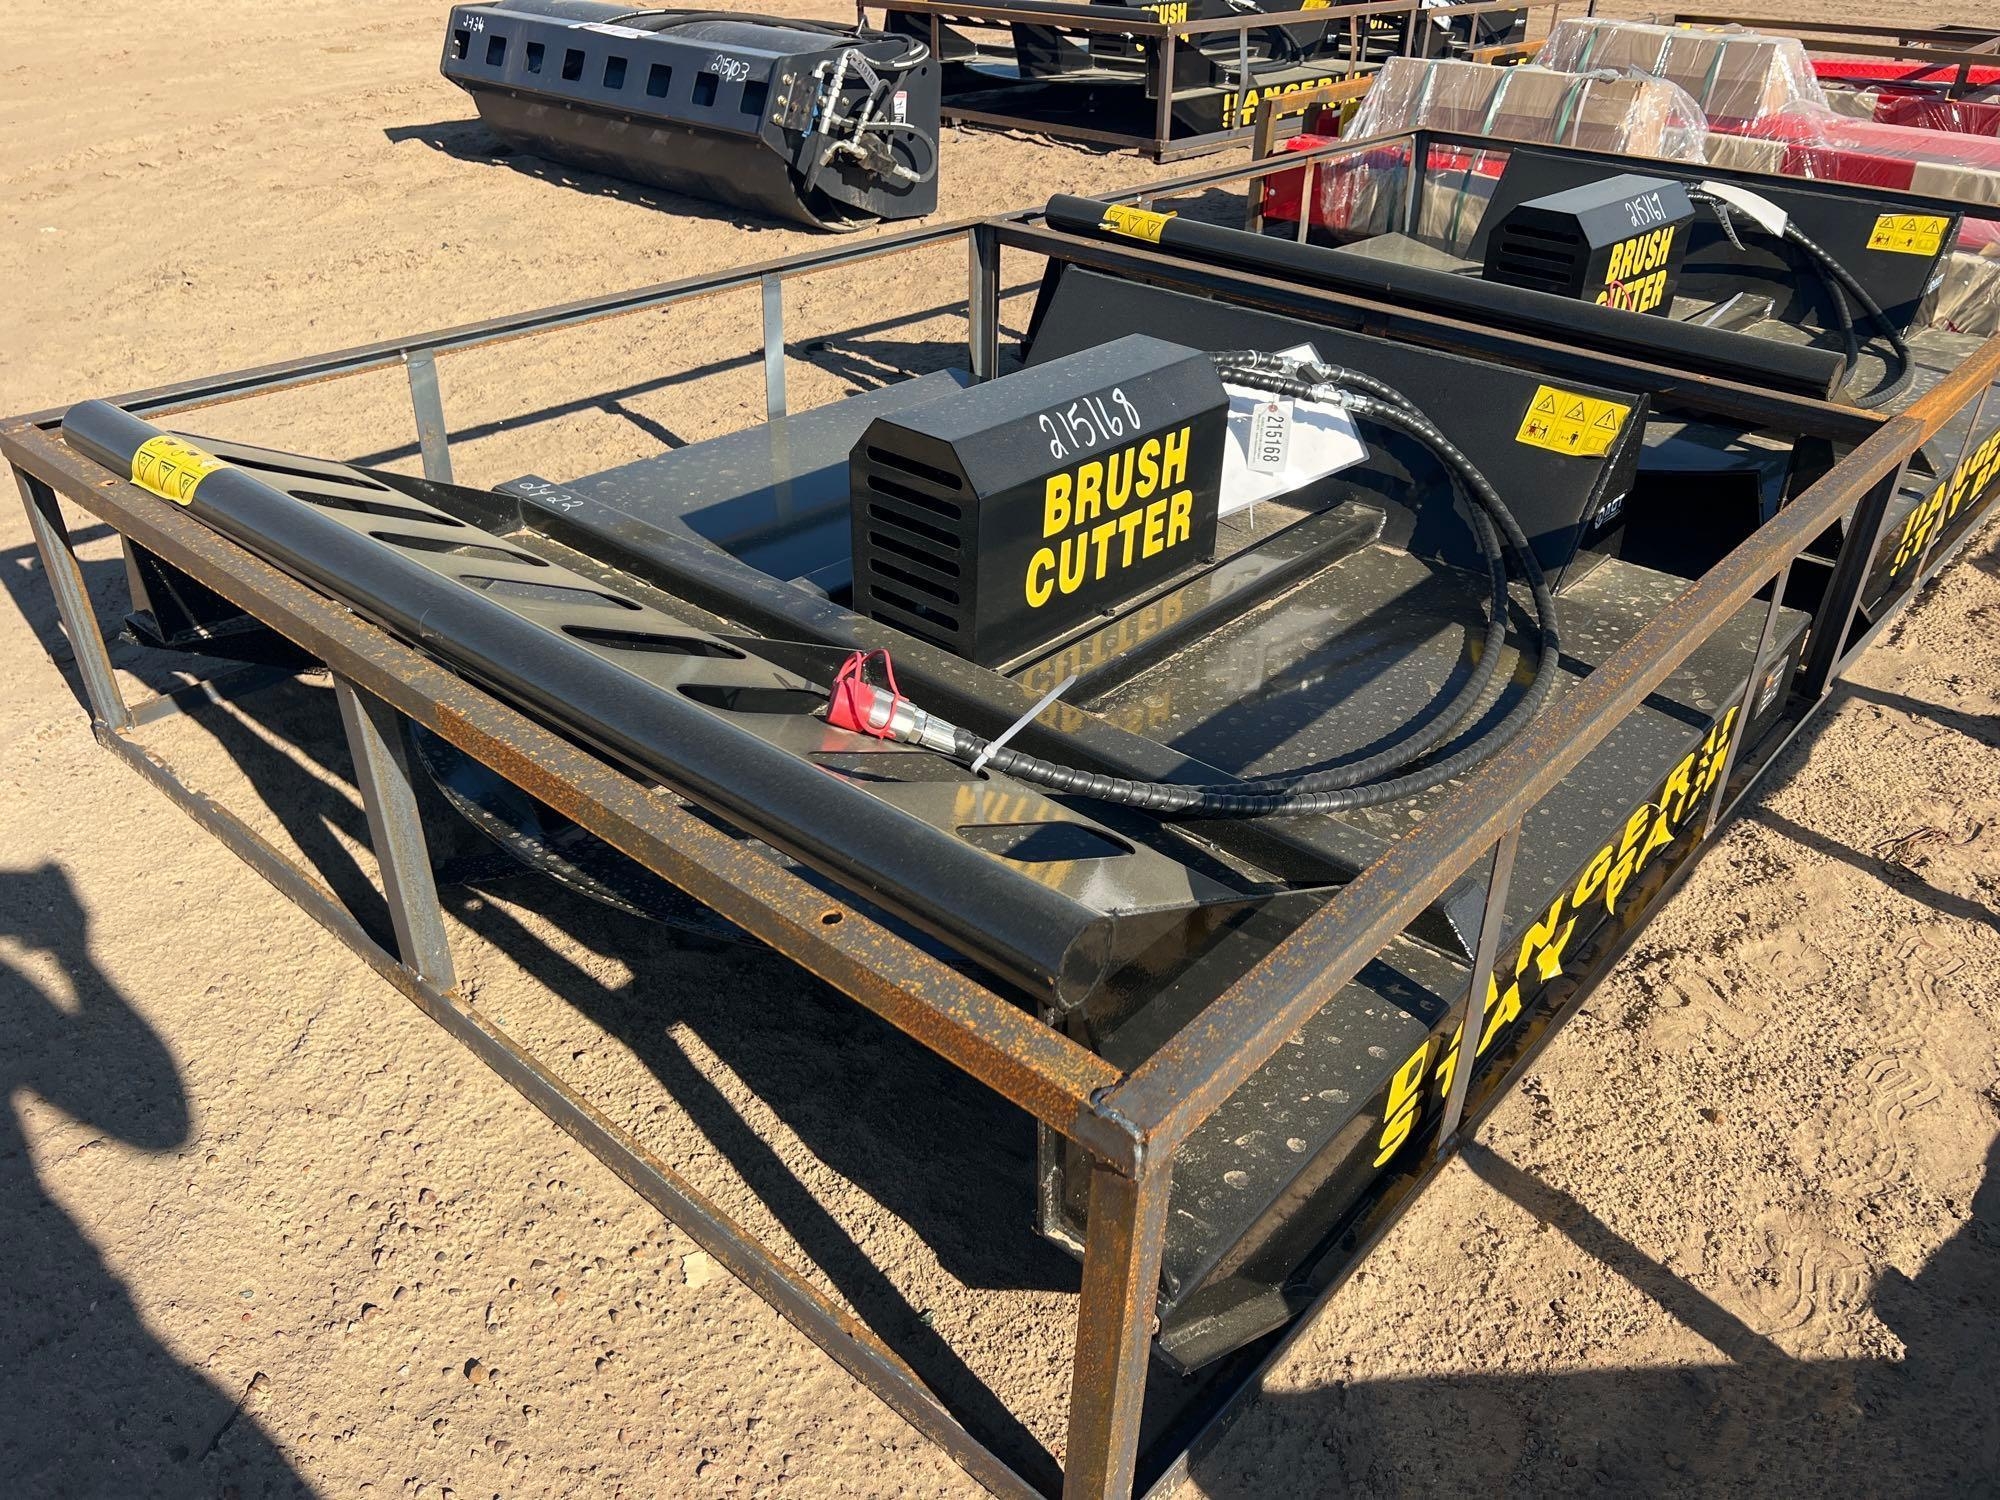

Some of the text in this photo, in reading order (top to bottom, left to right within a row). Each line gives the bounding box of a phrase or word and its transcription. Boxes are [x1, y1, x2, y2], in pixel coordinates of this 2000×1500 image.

[711, 54, 751, 83] 215103
[1624, 192, 1667, 227] 215167
[1605, 226, 1675, 285] BRUSH
[1038, 387, 1142, 460] 215168
[1262, 415, 1285, 463] 215168
[1043, 426, 1191, 538] BRUSH
[1025, 488, 1194, 609] CUTTER
